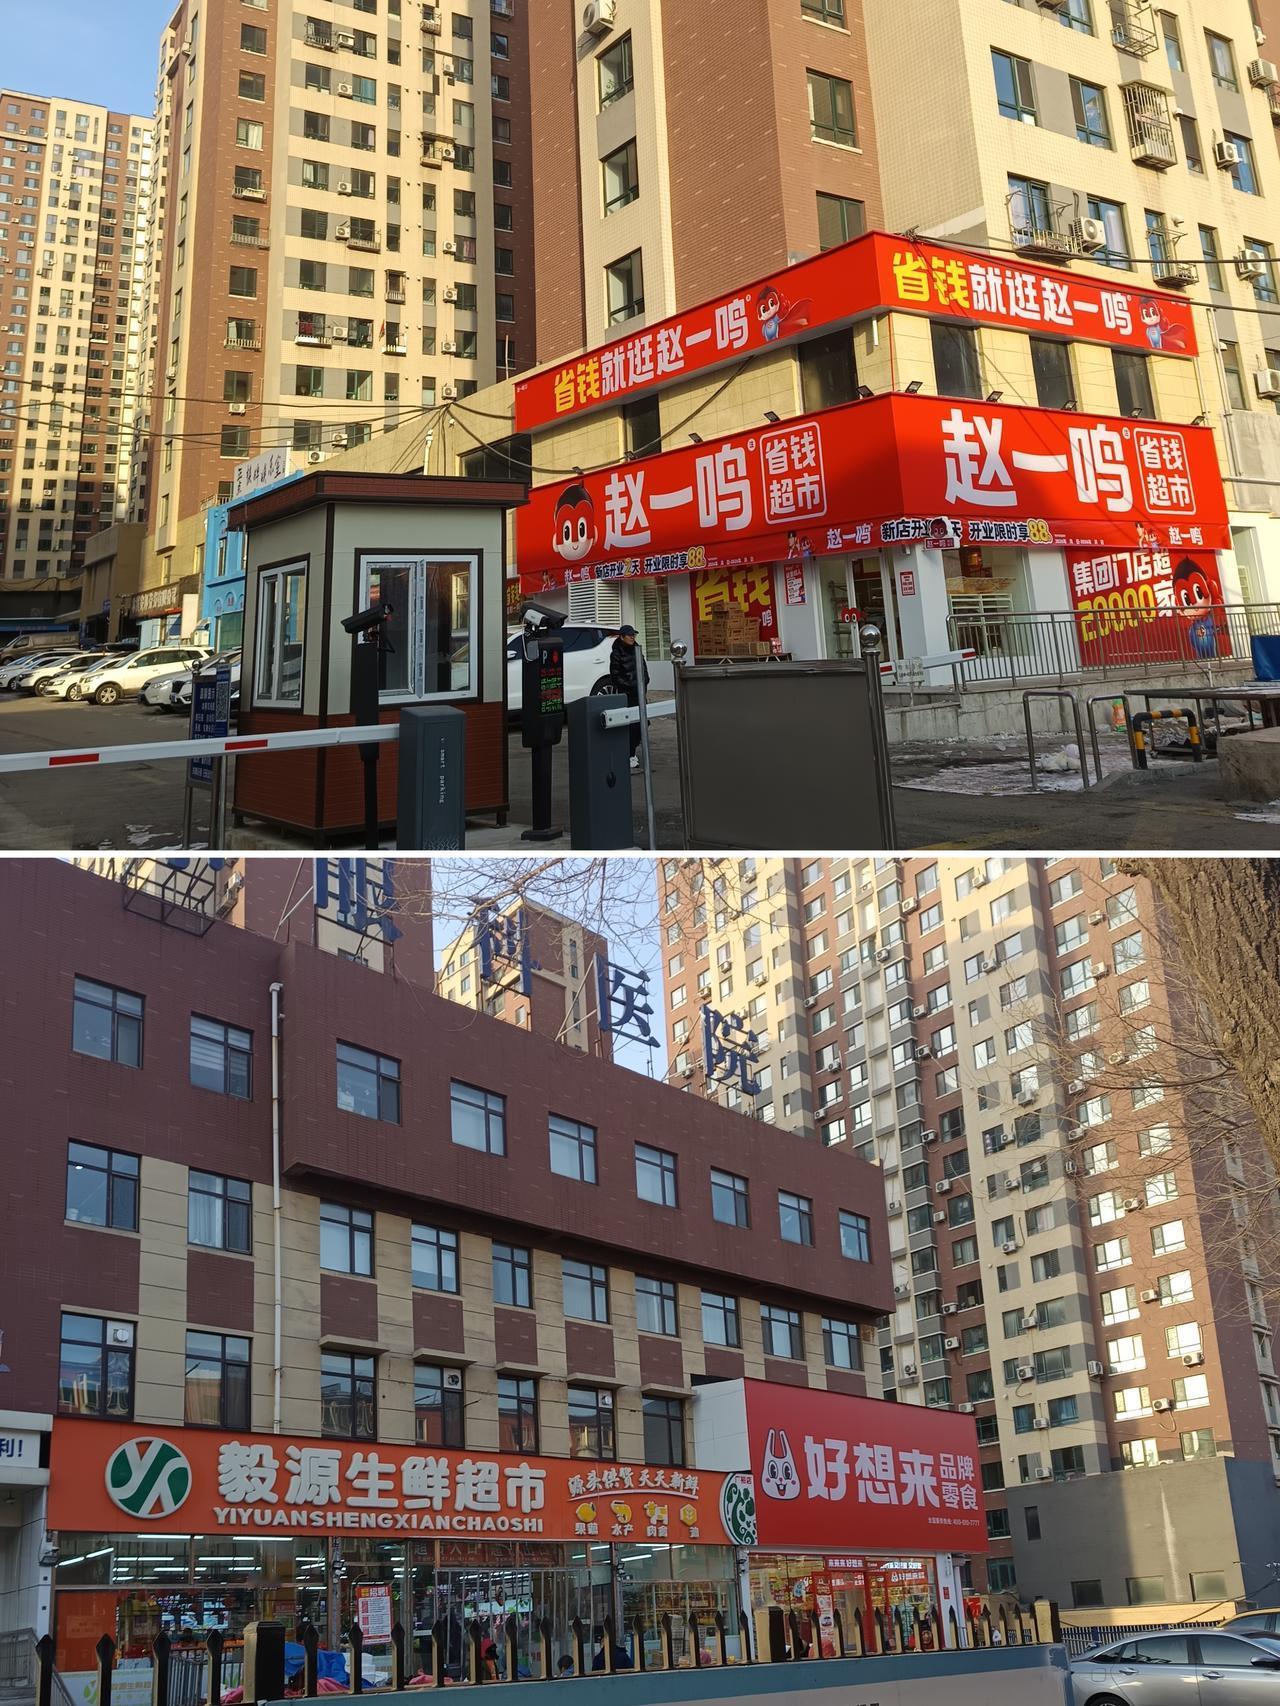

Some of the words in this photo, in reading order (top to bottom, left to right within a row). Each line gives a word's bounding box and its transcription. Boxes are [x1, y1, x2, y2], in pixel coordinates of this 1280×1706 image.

[893, 251, 1131, 336] 省钱就逛赵一鸣
[553, 297, 750, 412] 省钱就逛赵一鸣
[765, 431, 816, 475] 省钱
[941, 408, 1133, 513] 赵一鸣
[1139, 436, 1184, 471] 省钱
[603, 442, 753, 551] 赵一鸣
[769, 472, 821, 516] 超市
[1146, 474, 1192, 508] 超市
[827, 523, 872, 549] 赵一鸣
[881, 518, 962, 542] 新店开业天
[1168, 526, 1202, 546] 赵一鸣
[1073, 551, 1172, 597] 集团门店超
[218, 1441, 546, 1513] 毅源生鲜超市
[568, 1467, 635, 1497] 源头供货
[638, 1469, 699, 1496] 天天新鲜
[804, 1436, 940, 1508] 好想来
[940, 1453, 975, 1481] 品牌
[942, 1483, 978, 1511] 零食
[213, 1506, 544, 1533] YIYUANSHENGXIANCHAOSHI
[611, 1523, 634, 1536] 水产
